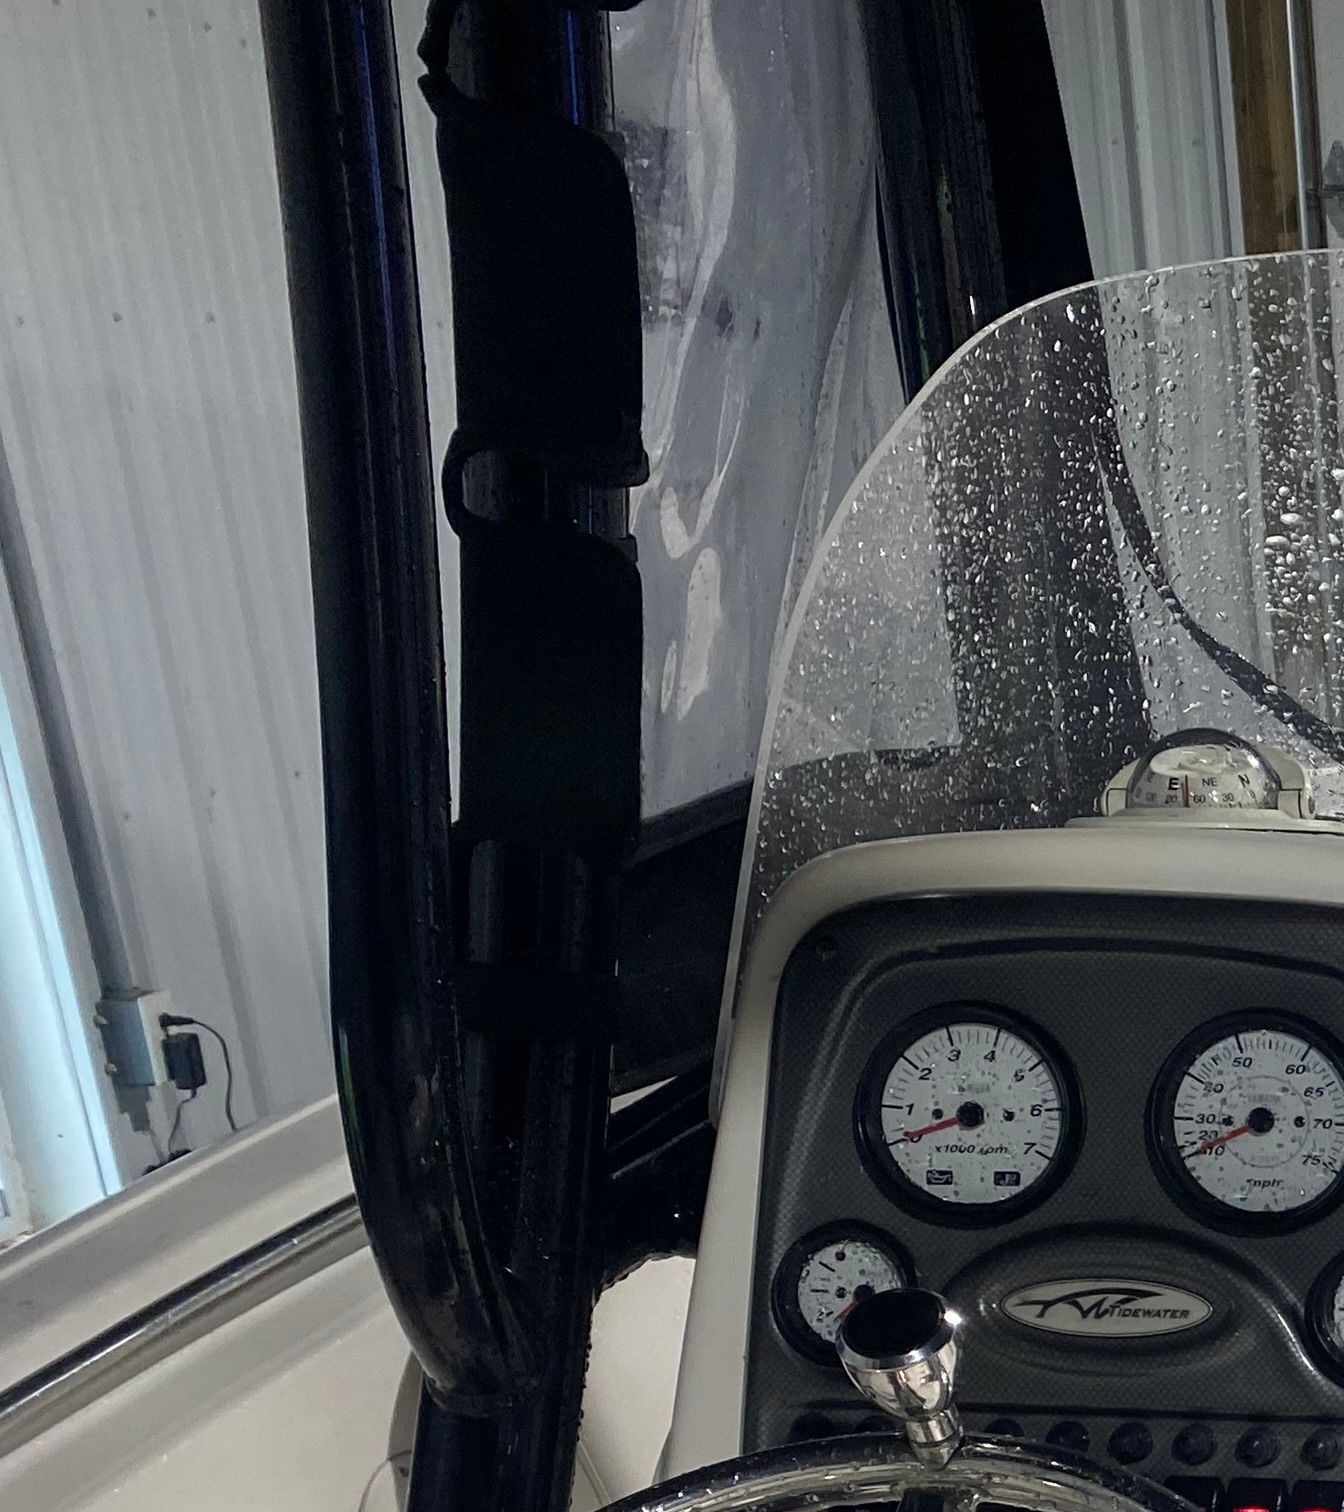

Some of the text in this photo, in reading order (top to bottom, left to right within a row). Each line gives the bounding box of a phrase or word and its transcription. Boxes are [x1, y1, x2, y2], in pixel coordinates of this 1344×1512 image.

[1168, 773, 1250, 790] E NE N
[948, 1050, 961, 1062] 3
[983, 1050, 996, 1063] 4
[1231, 1056, 1253, 1068] 50
[918, 1068, 932, 1081] 2
[1285, 1064, 1306, 1075] 60
[1303, 1086, 1325, 1098] 65
[904, 1103, 914, 1116] 1
[1030, 1104, 1043, 1117] 6
[1195, 1114, 1216, 1125] 30
[1312, 1118, 1333, 1130] 70
[1023, 1142, 1037, 1155] 7
[1302, 1154, 1321, 1166] 75
[1108, 1304, 1190, 1319] TIDEWATER
